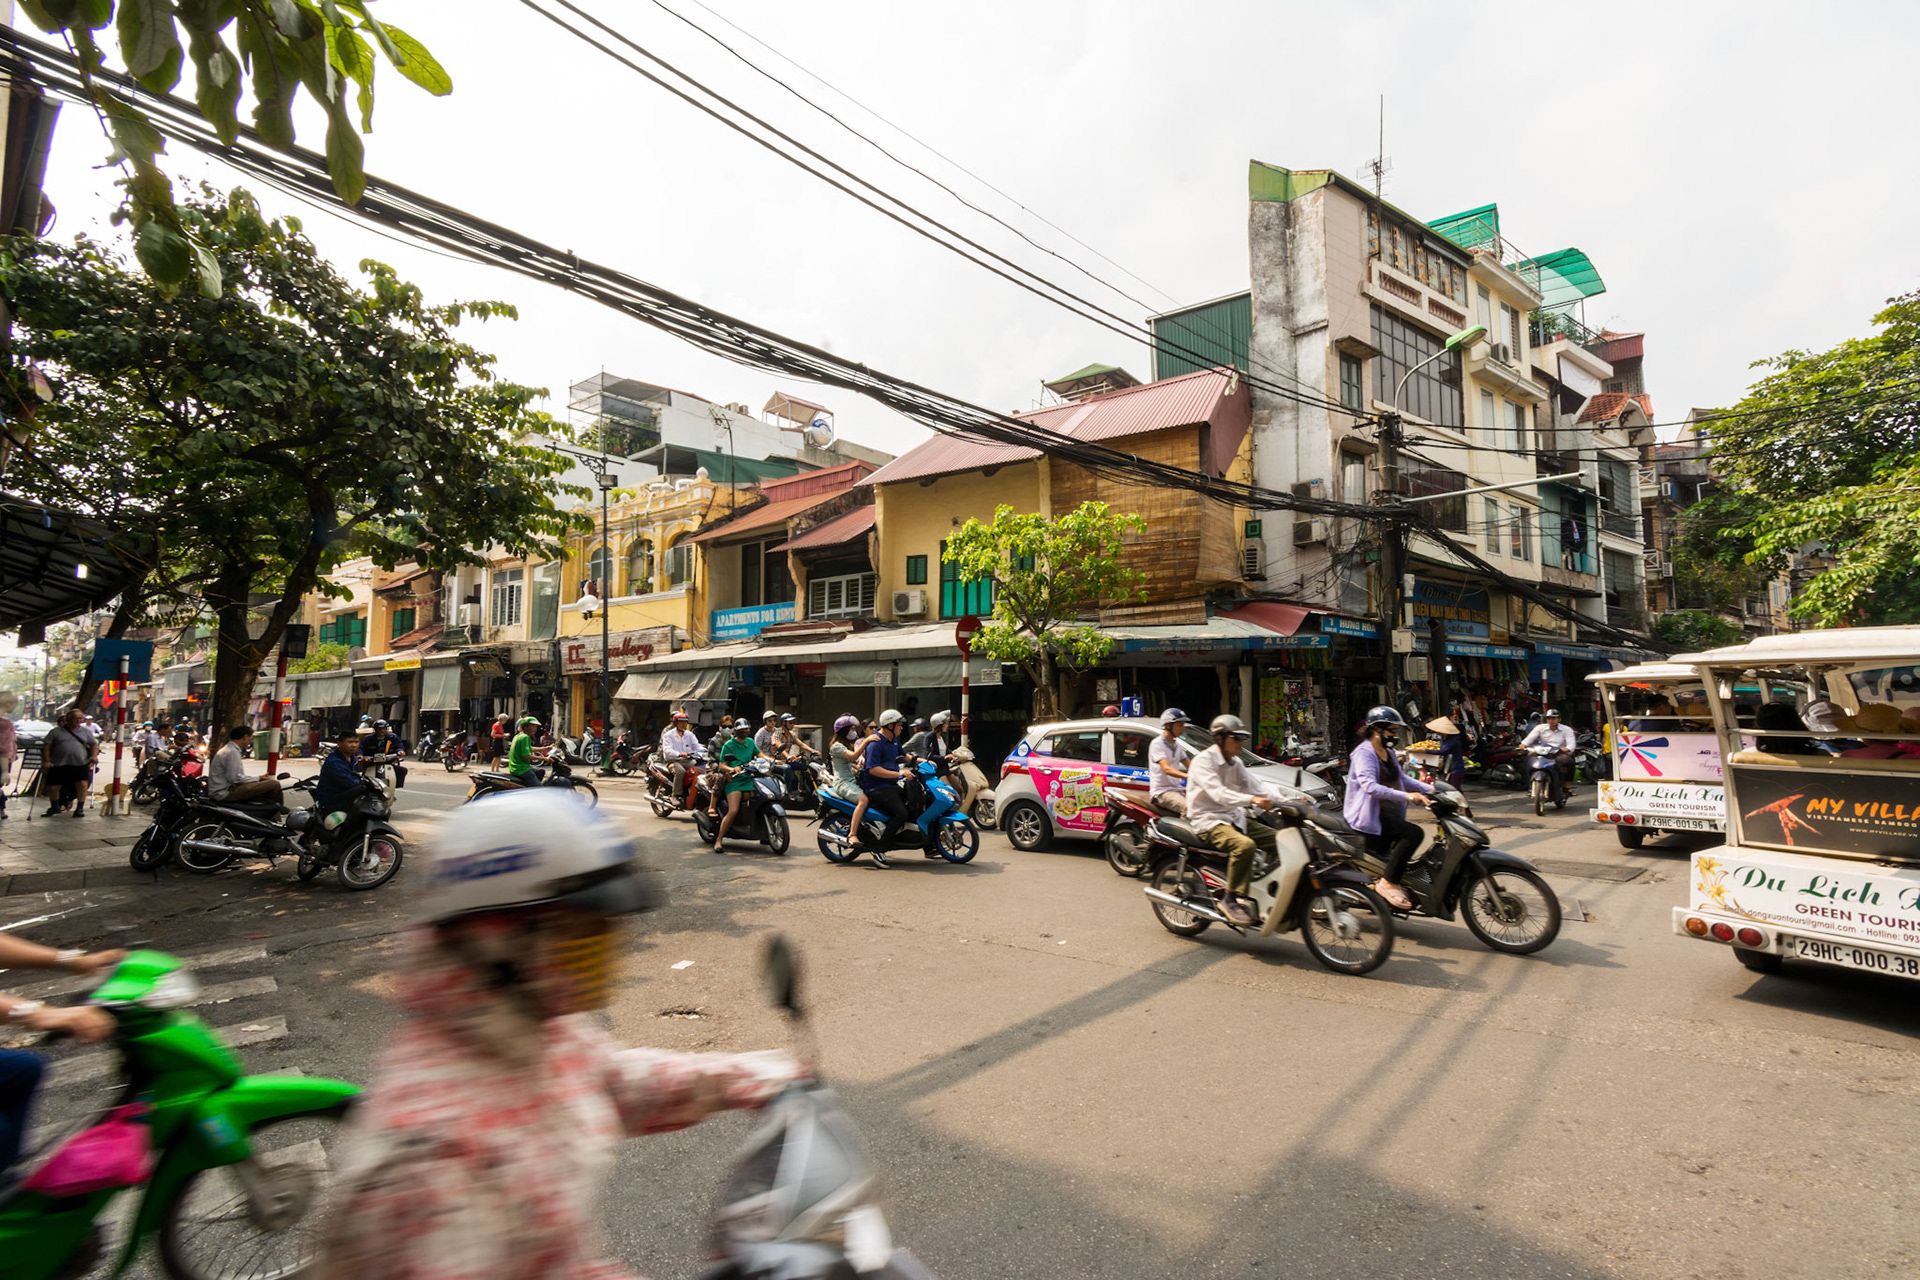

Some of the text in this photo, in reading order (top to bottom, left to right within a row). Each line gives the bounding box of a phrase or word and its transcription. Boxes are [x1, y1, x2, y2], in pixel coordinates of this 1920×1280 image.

[716, 607, 795, 627] APARTMENTS FOR RENT
[1310, 636, 1320, 645] 2
[1619, 785, 1723, 802] Du Lịch Xa
[1806, 797, 1845, 814] MY
[1806, 814, 1918, 828] VIETNAMESE BAMBOO
[1734, 865, 1788, 892] Du
[1799, 875, 1886, 907] Lịch
[1795, 903, 1852, 922] GREEN
[1866, 928, 1900, 941] Hotline:
[1798, 940, 1919, 976] 29HC-000.38
